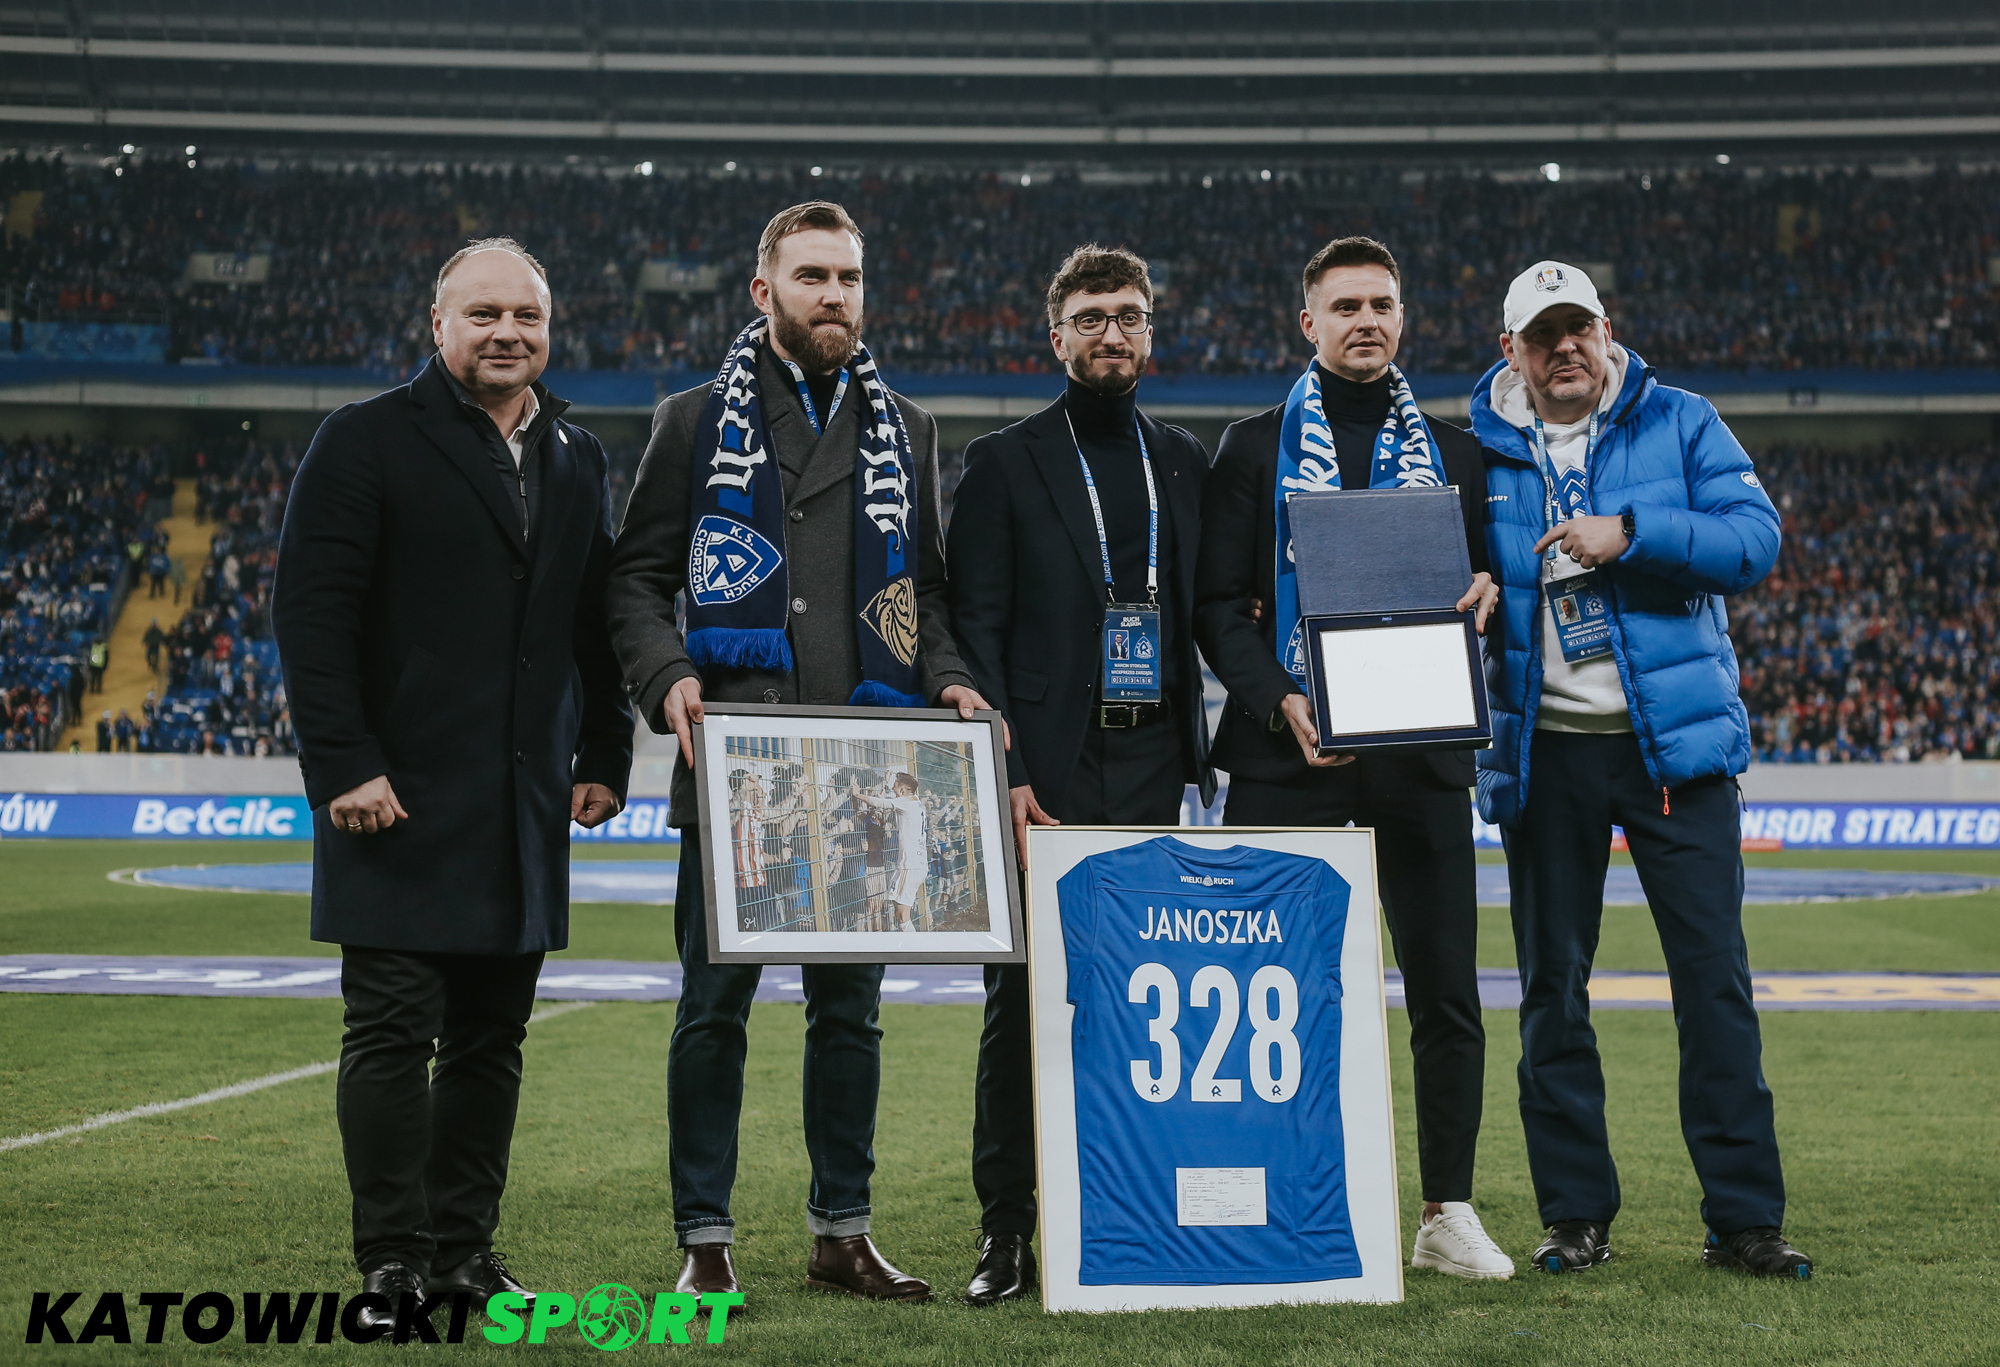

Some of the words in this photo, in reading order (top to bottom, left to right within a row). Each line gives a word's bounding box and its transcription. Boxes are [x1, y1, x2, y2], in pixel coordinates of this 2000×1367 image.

[713, 349, 738, 395] KIBICE!
[801, 392, 813, 413] RUCH
[1590, 420, 1598, 436] 22/23
[1090, 488, 1106, 532] ksruch.com
[729, 525, 743, 540] K.
[744, 532, 754, 547] S.
[1149, 512, 1159, 558] ksruch.com
[723, 573, 760, 600] RUCH
[0, 793, 58, 832] ÓW
[132, 798, 297, 836] Betclic
[1180, 875, 1202, 884] WIELKI
[1213, 877, 1234, 886] RUCH
[1139, 906, 1283, 944] JANOSZKA
[1128, 962, 1302, 1103] 328
